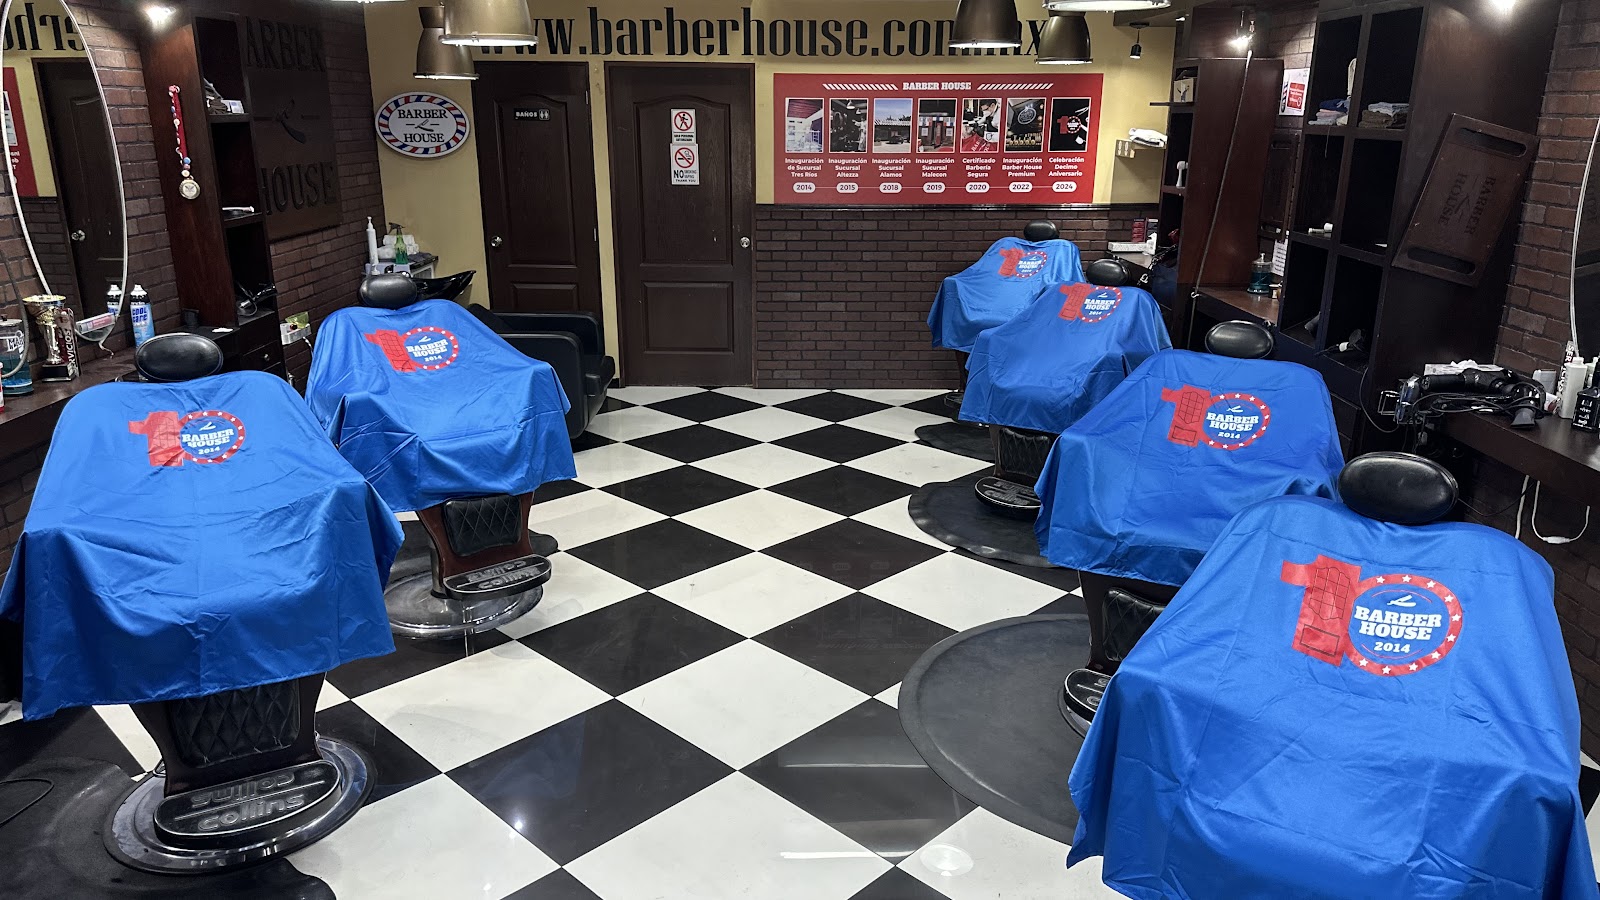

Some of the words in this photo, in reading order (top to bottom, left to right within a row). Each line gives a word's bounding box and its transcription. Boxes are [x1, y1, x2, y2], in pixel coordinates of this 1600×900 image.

[246, 15, 327, 72] ARBER
[903, 82, 940, 91] BARBER
[941, 82, 972, 90] HOUSE
[397, 109, 448, 119] BARBER
[403, 133, 445, 143] HOUSE
[784, 157, 824, 165] Inauguración
[828, 157, 868, 165] Inauguración
[871, 157, 911, 165] Inauguración
[915, 157, 955, 165] Inauguración
[673, 169, 684, 179] NO
[967, 171, 989, 179] Segura
[405, 338, 449, 353] BARBER
[412, 346, 448, 358] HOUSE
[1206, 412, 1259, 424] BARBER
[1209, 420, 1254, 432] HOUSE
[181, 428, 234, 443] BARBER
[1217, 431, 1241, 439] 2014
[187, 436, 230, 448] HOUSE
[198, 446, 220, 455] 2014
[1354, 605, 1442, 628] BARBER
[1359, 622, 1434, 641] HOUSE
[1373, 641, 1411, 653] 2014
[198, 794, 305, 831] collins
